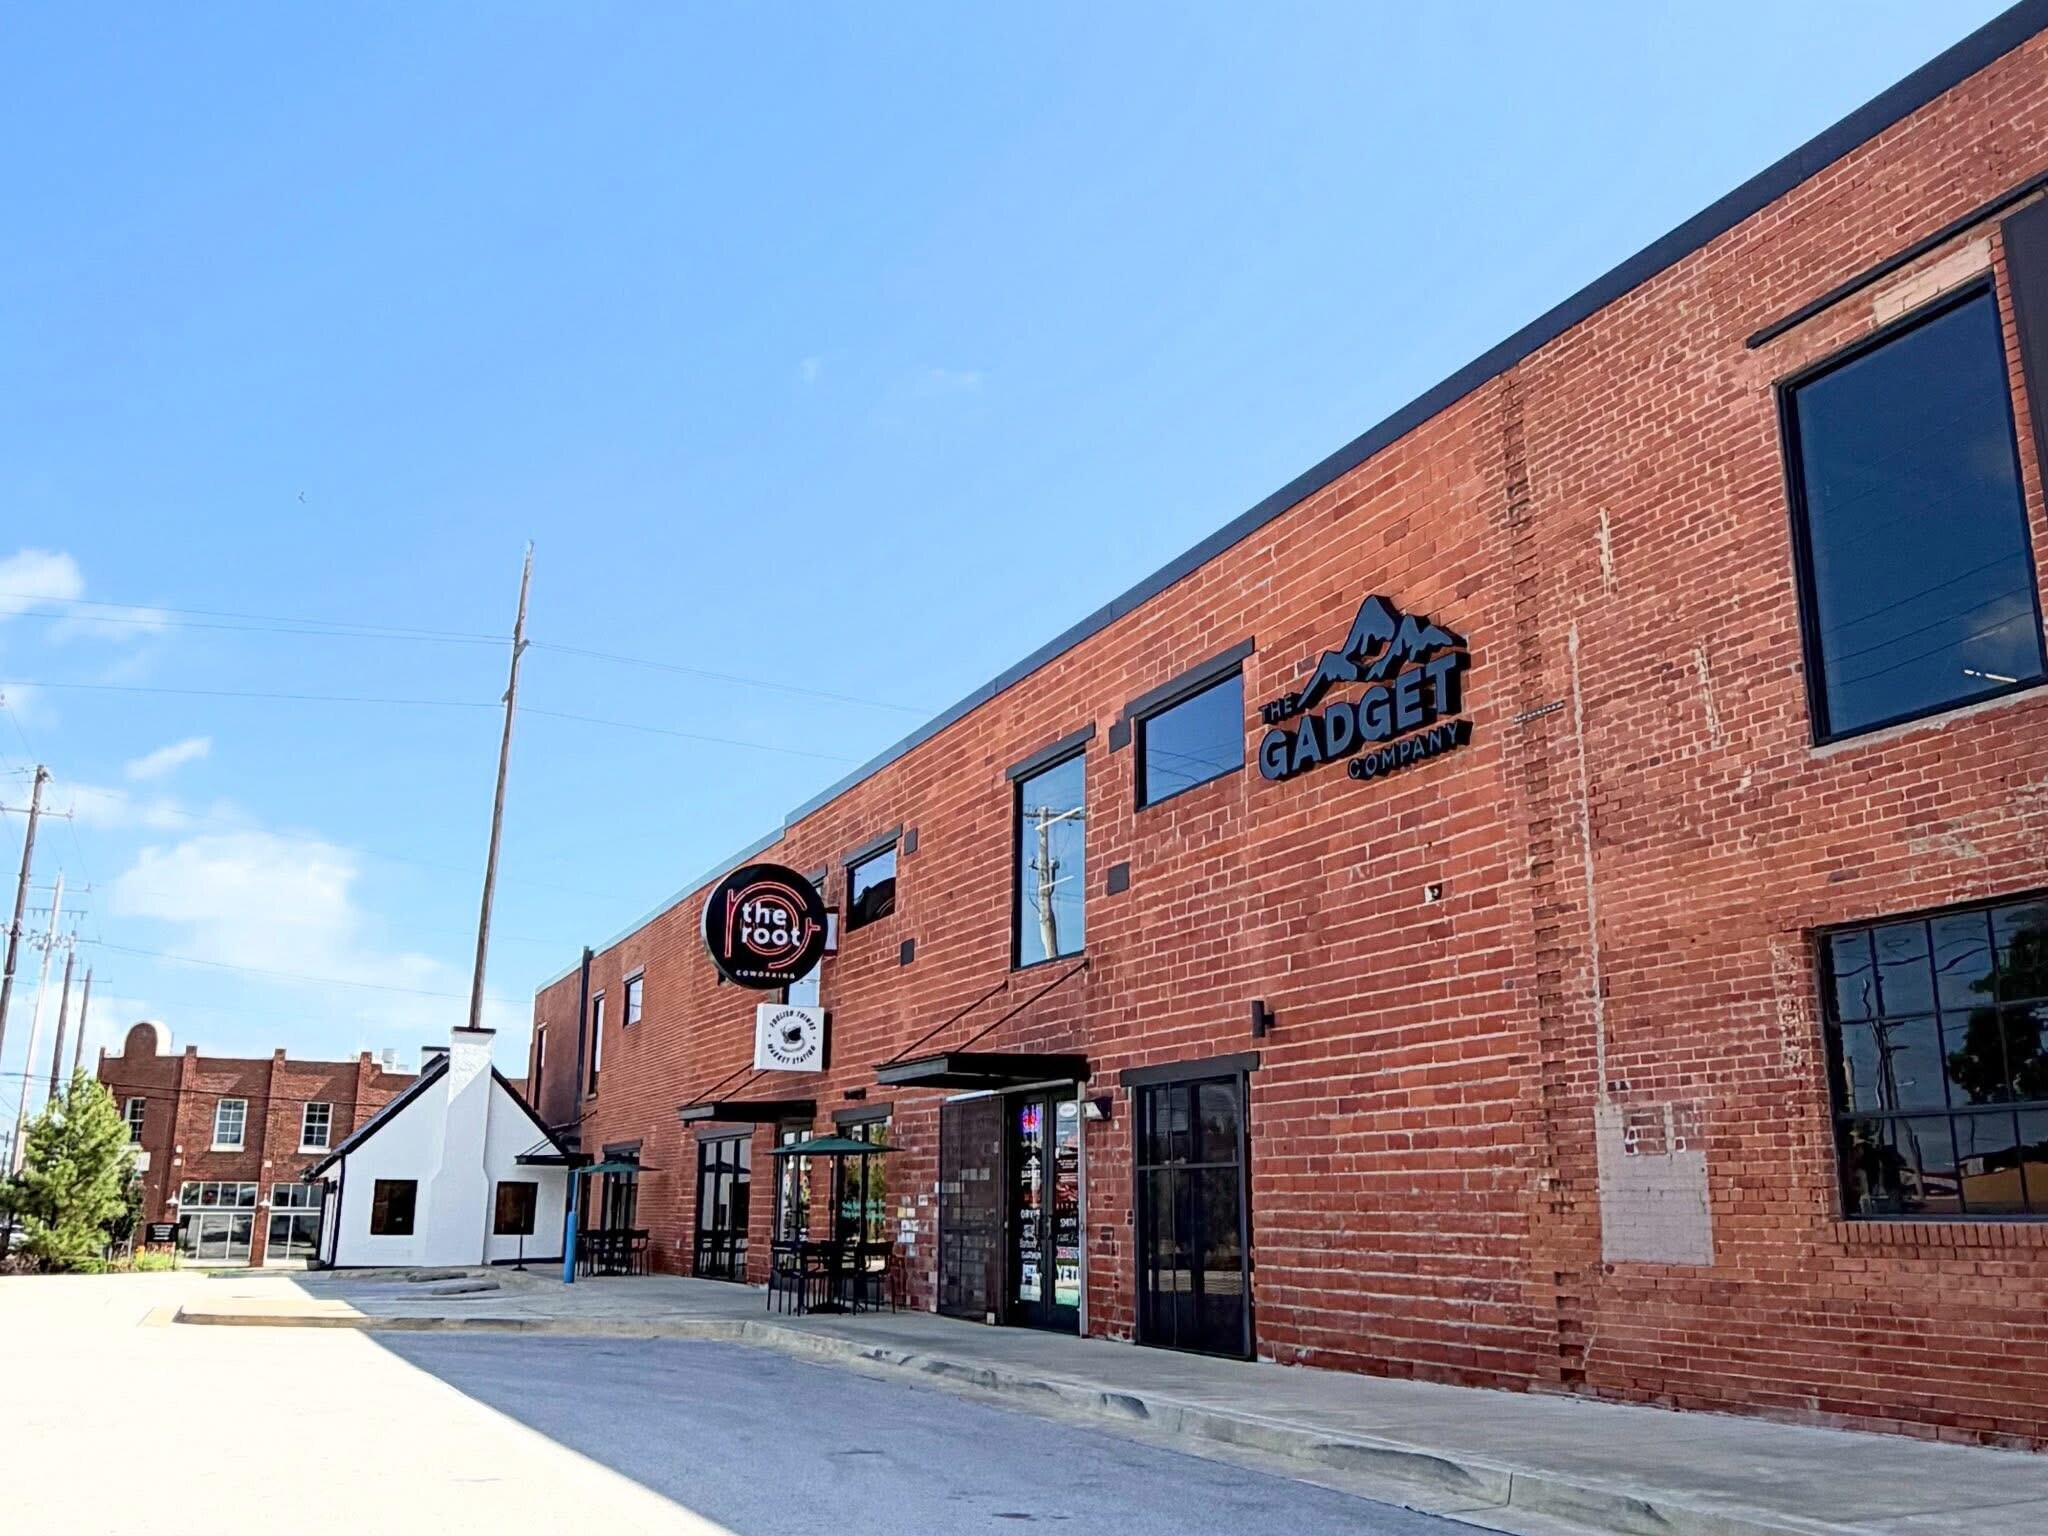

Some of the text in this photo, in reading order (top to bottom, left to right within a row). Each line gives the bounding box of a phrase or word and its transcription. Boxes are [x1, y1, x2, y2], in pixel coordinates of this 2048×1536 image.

[1259, 693, 1299, 724] THE
[1260, 652, 1464, 780] GADGET
[1348, 721, 1465, 780] COMPANY
[742, 901, 788, 926] the
[741, 926, 801, 946] root
[1056, 1265, 1079, 1282] YETI
